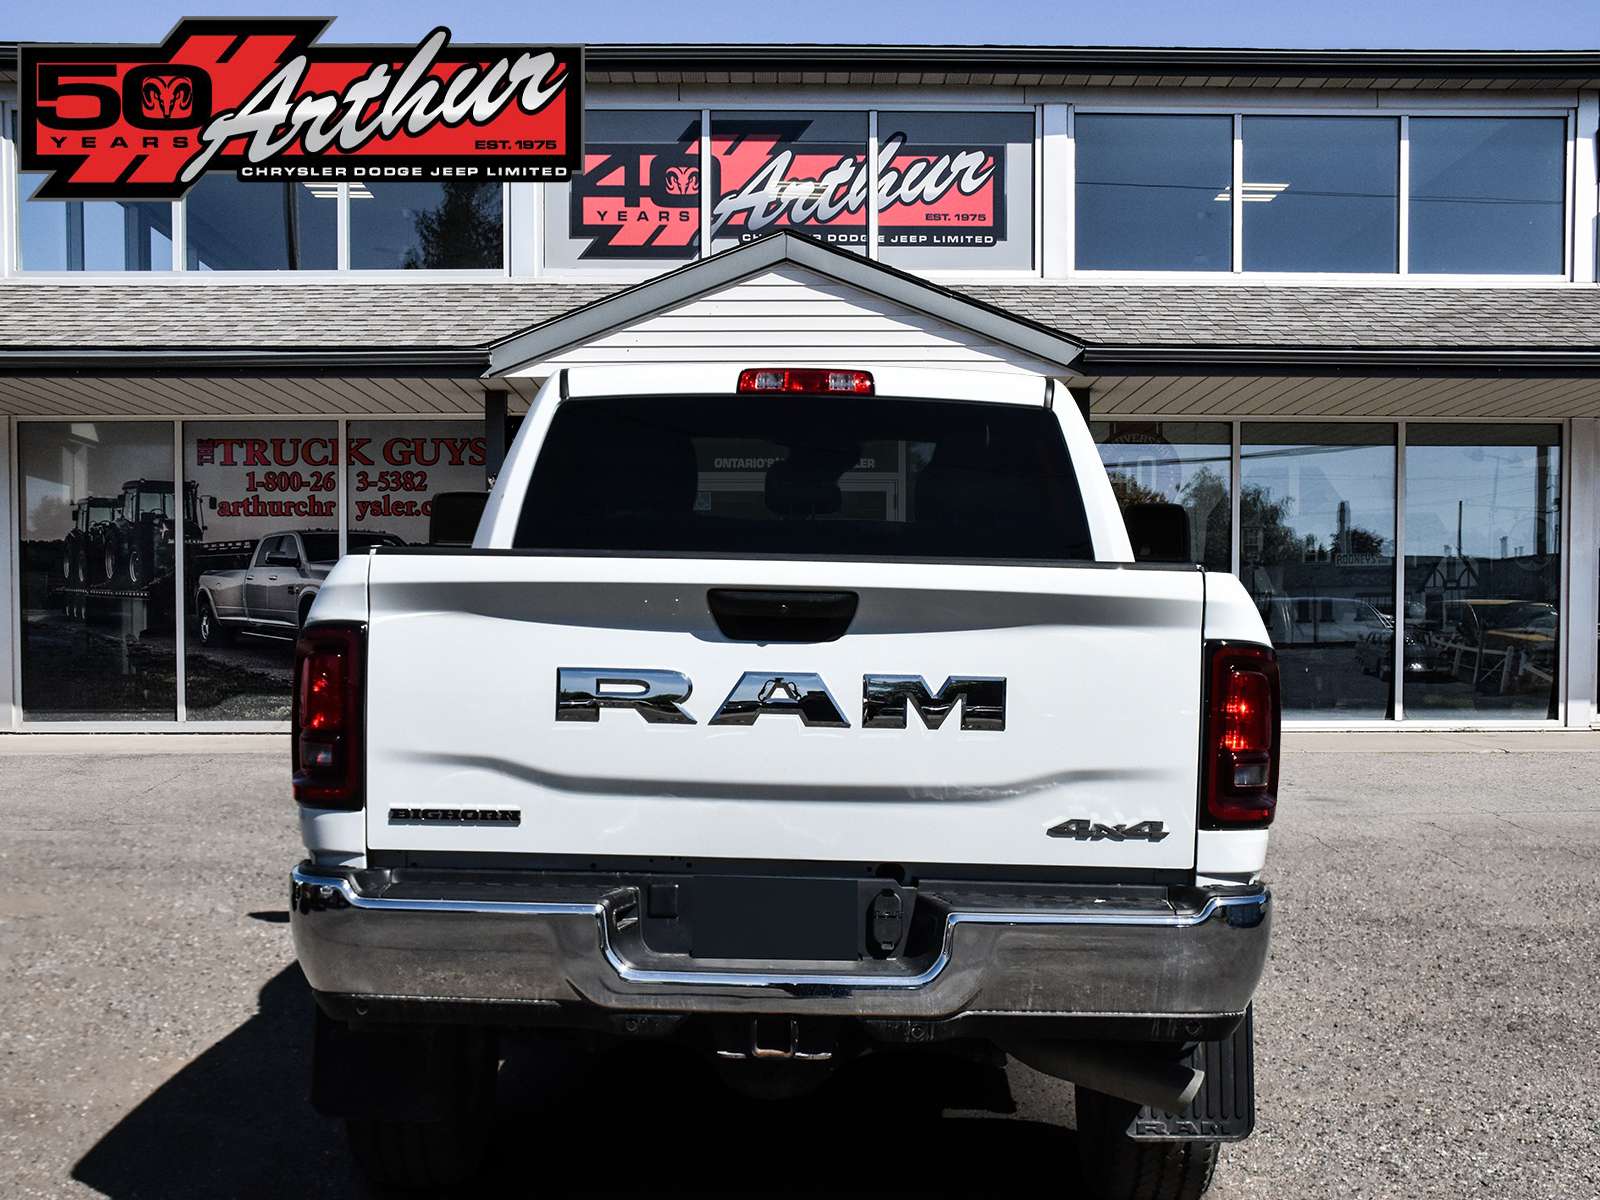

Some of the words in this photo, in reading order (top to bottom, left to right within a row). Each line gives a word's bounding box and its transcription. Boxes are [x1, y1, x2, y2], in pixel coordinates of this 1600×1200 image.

[580, 152, 722, 209] 40
[711, 135, 996, 233] Arthur
[597, 210, 690, 222] YEARS
[924, 213, 951, 222] EST.
[954, 213, 987, 222] 1975
[891, 235, 928, 244] JEEP
[933, 235, 994, 244] LIMITED
[214, 437, 375, 467] TRUCK
[382, 437, 488, 467] GUYS
[217, 494, 432, 521] arthurchrysler.c
[555, 666, 1007, 732] RAM
[388, 808, 520, 826] BIGHORN
[1136, 1120, 1231, 1136] RAM
